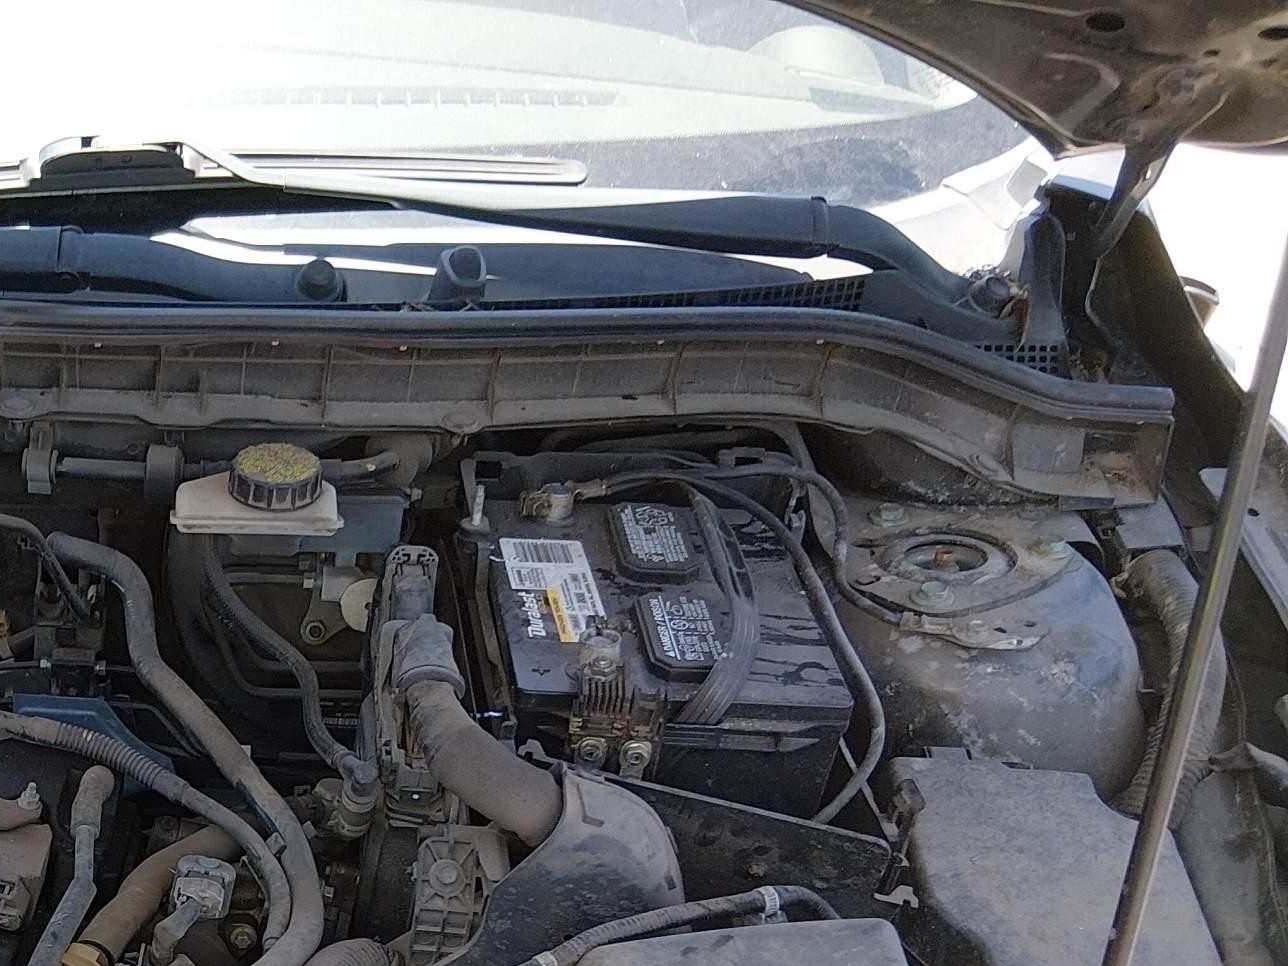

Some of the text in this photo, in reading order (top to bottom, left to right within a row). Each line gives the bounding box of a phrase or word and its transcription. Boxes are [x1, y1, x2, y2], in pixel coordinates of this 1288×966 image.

[518, 592, 546, 637] Duralast
[649, 599, 664, 620] POISON
[657, 626, 673, 650] DANGER
